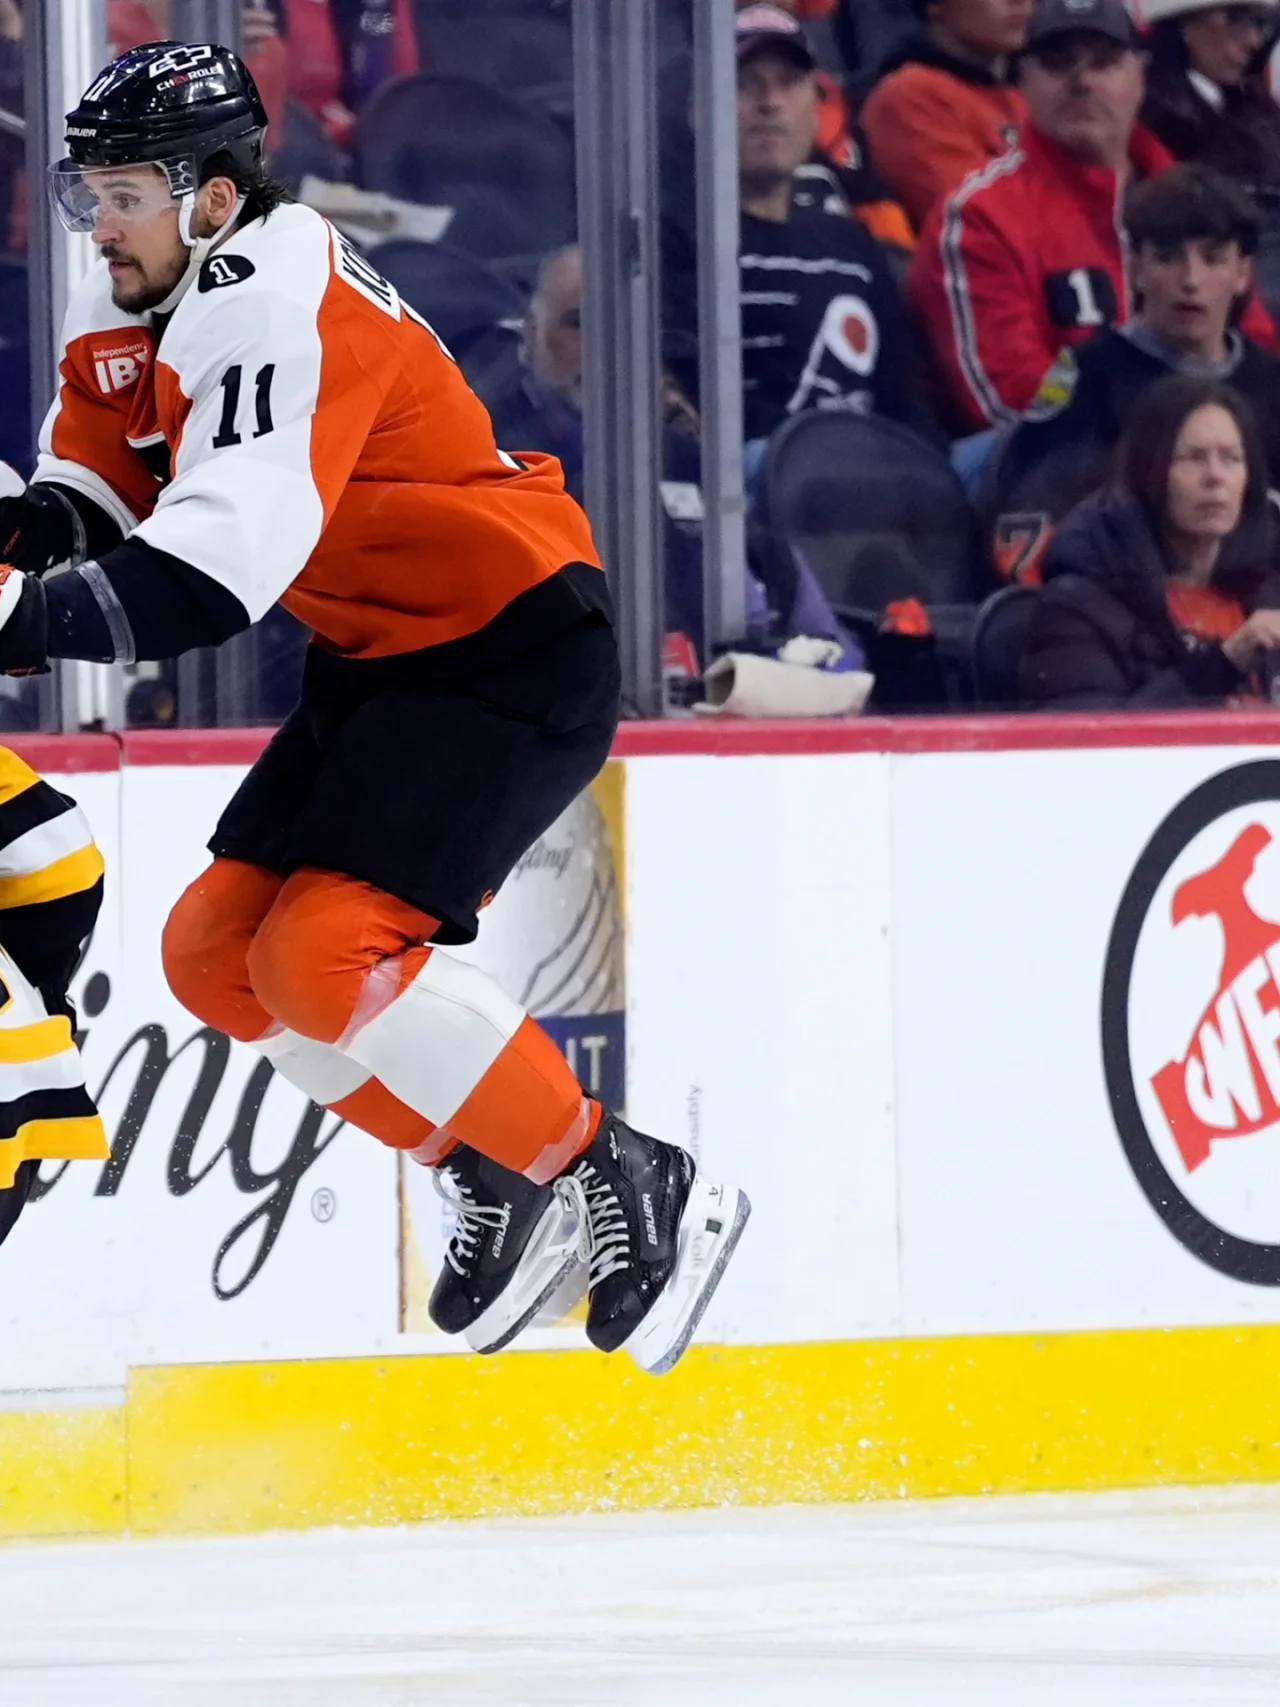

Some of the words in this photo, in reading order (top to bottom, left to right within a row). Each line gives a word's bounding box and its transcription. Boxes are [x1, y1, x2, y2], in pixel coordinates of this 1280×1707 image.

[1068, 268, 1104, 326] 1
[212, 363, 276, 450] 11
[1184, 936, 1280, 1132] WE
